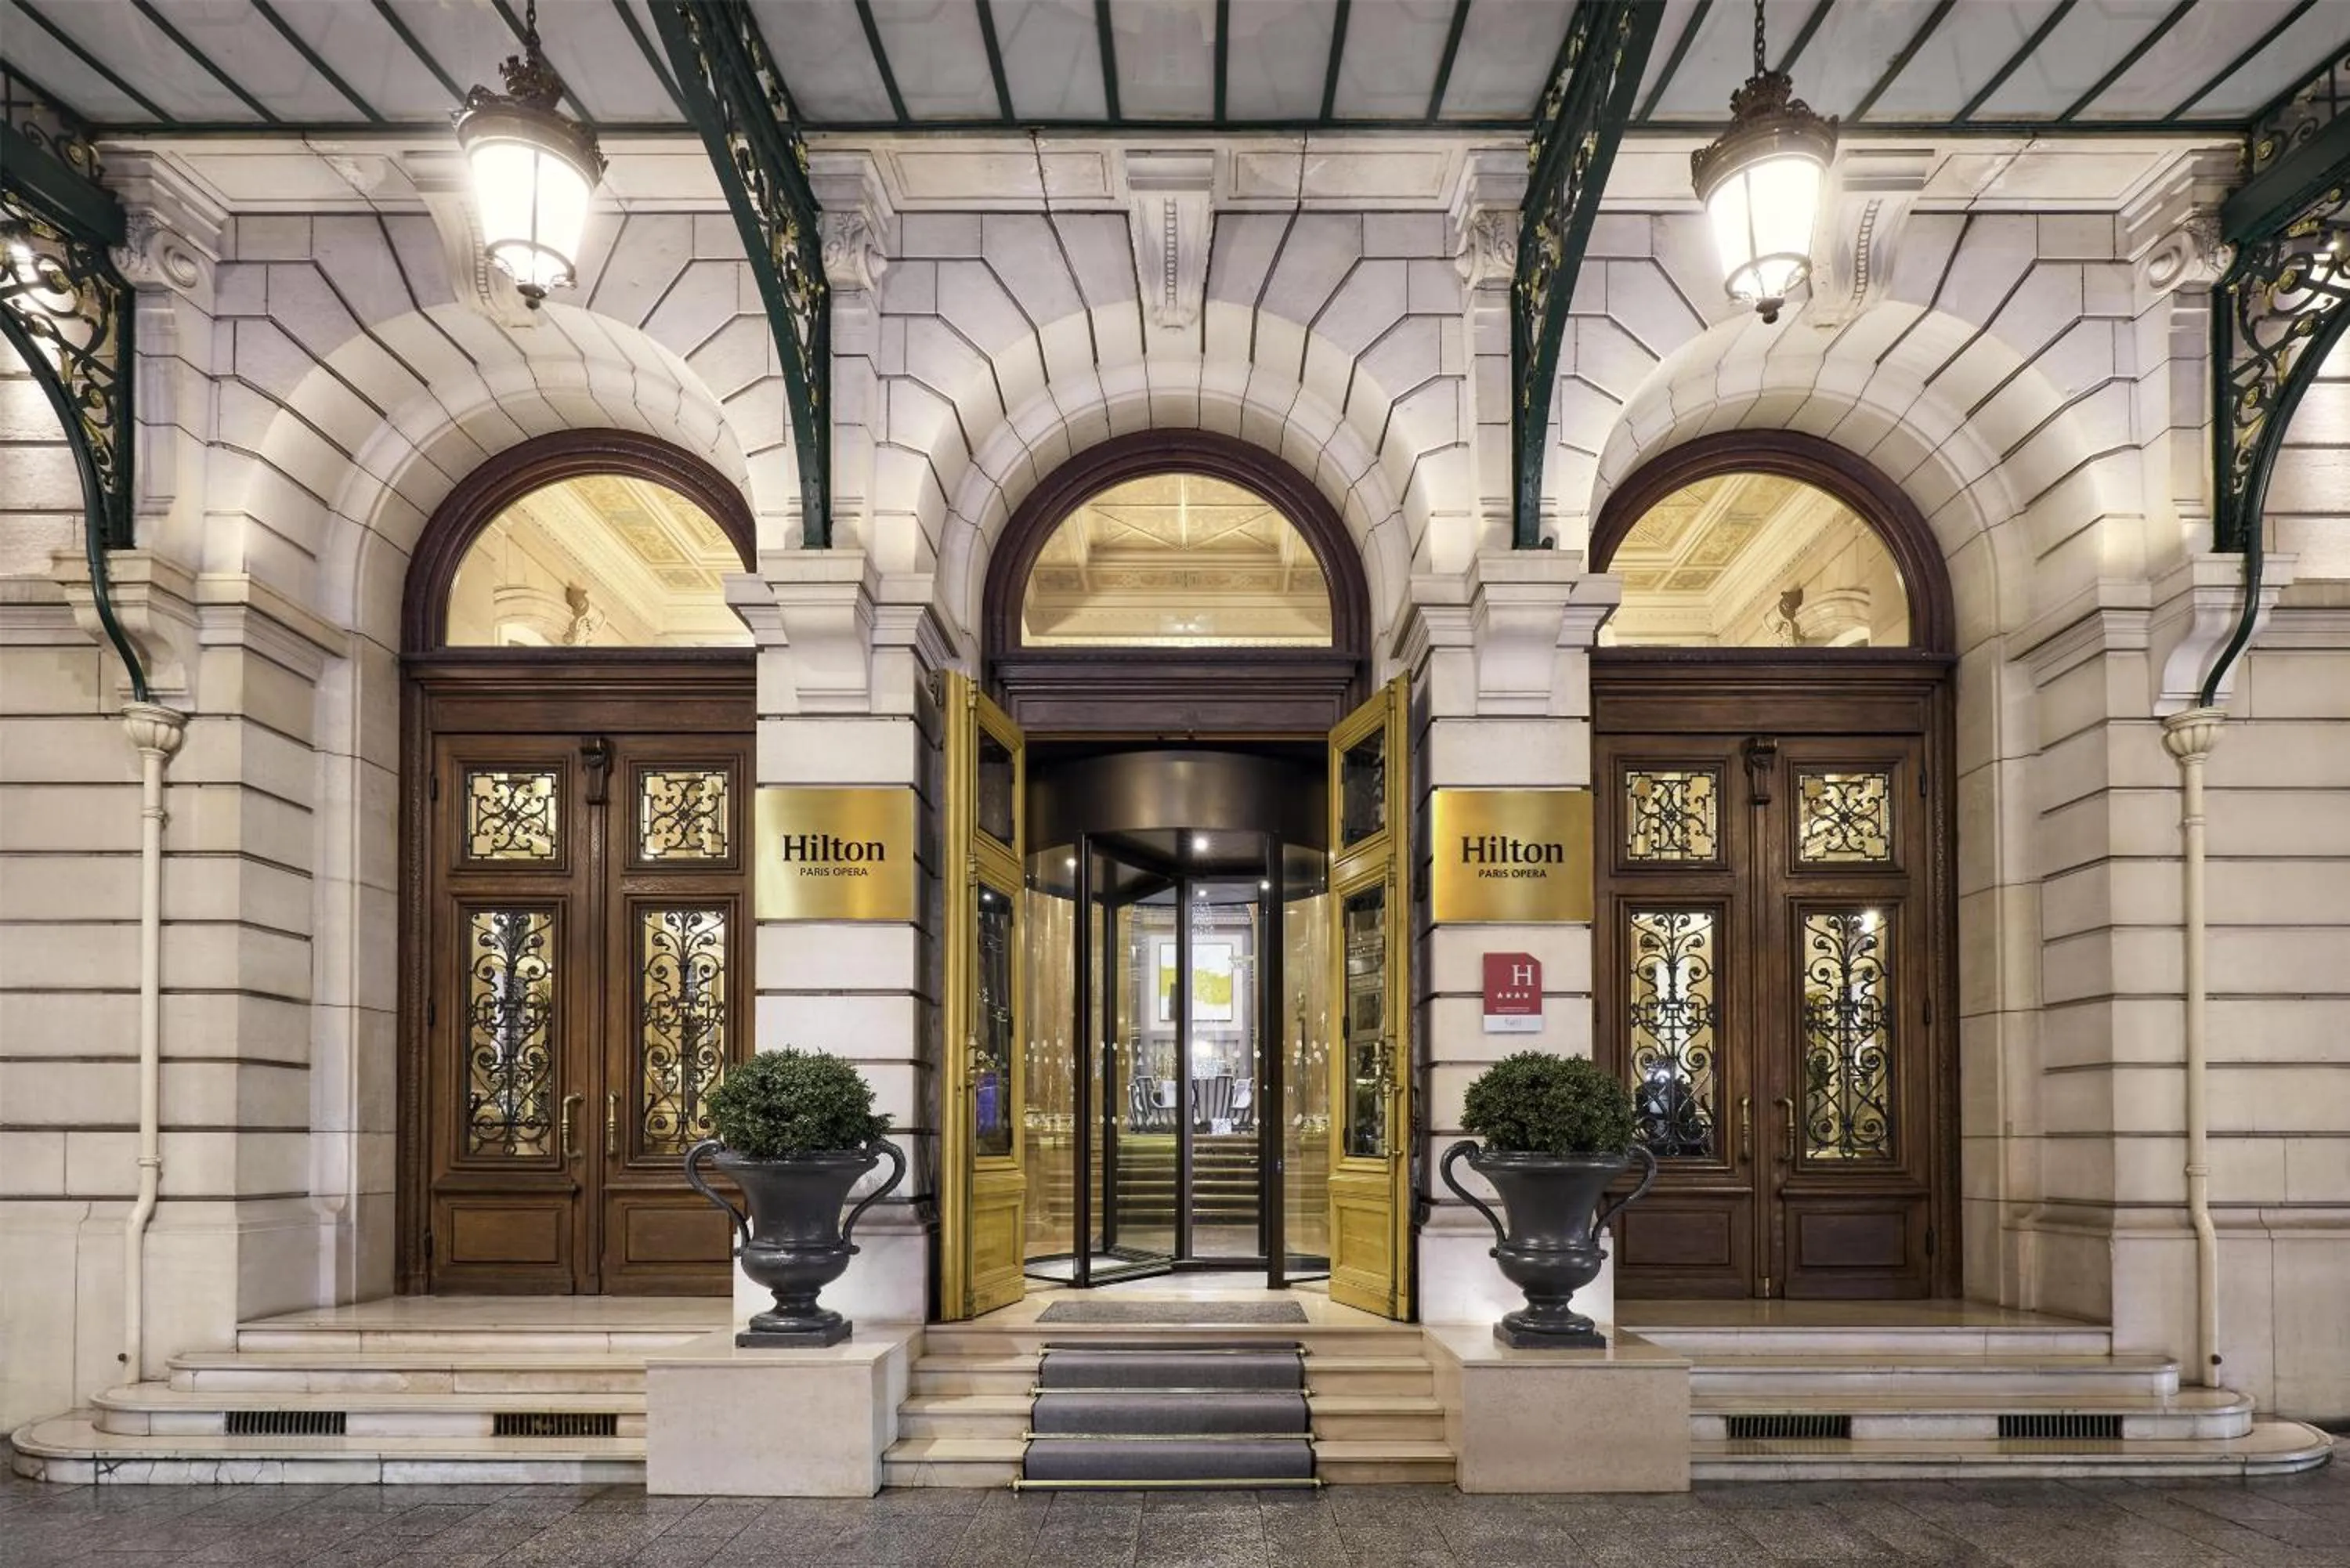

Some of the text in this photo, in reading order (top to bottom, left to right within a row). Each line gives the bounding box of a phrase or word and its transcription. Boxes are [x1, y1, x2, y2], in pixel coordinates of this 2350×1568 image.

[783, 834, 885, 862] Hilton
[1462, 836, 1564, 863] Hilton
[800, 868, 868, 876] PARIS OPERA
[1478, 869, 1547, 878] PARIS OPERA
[1511, 964, 1535, 986] H
